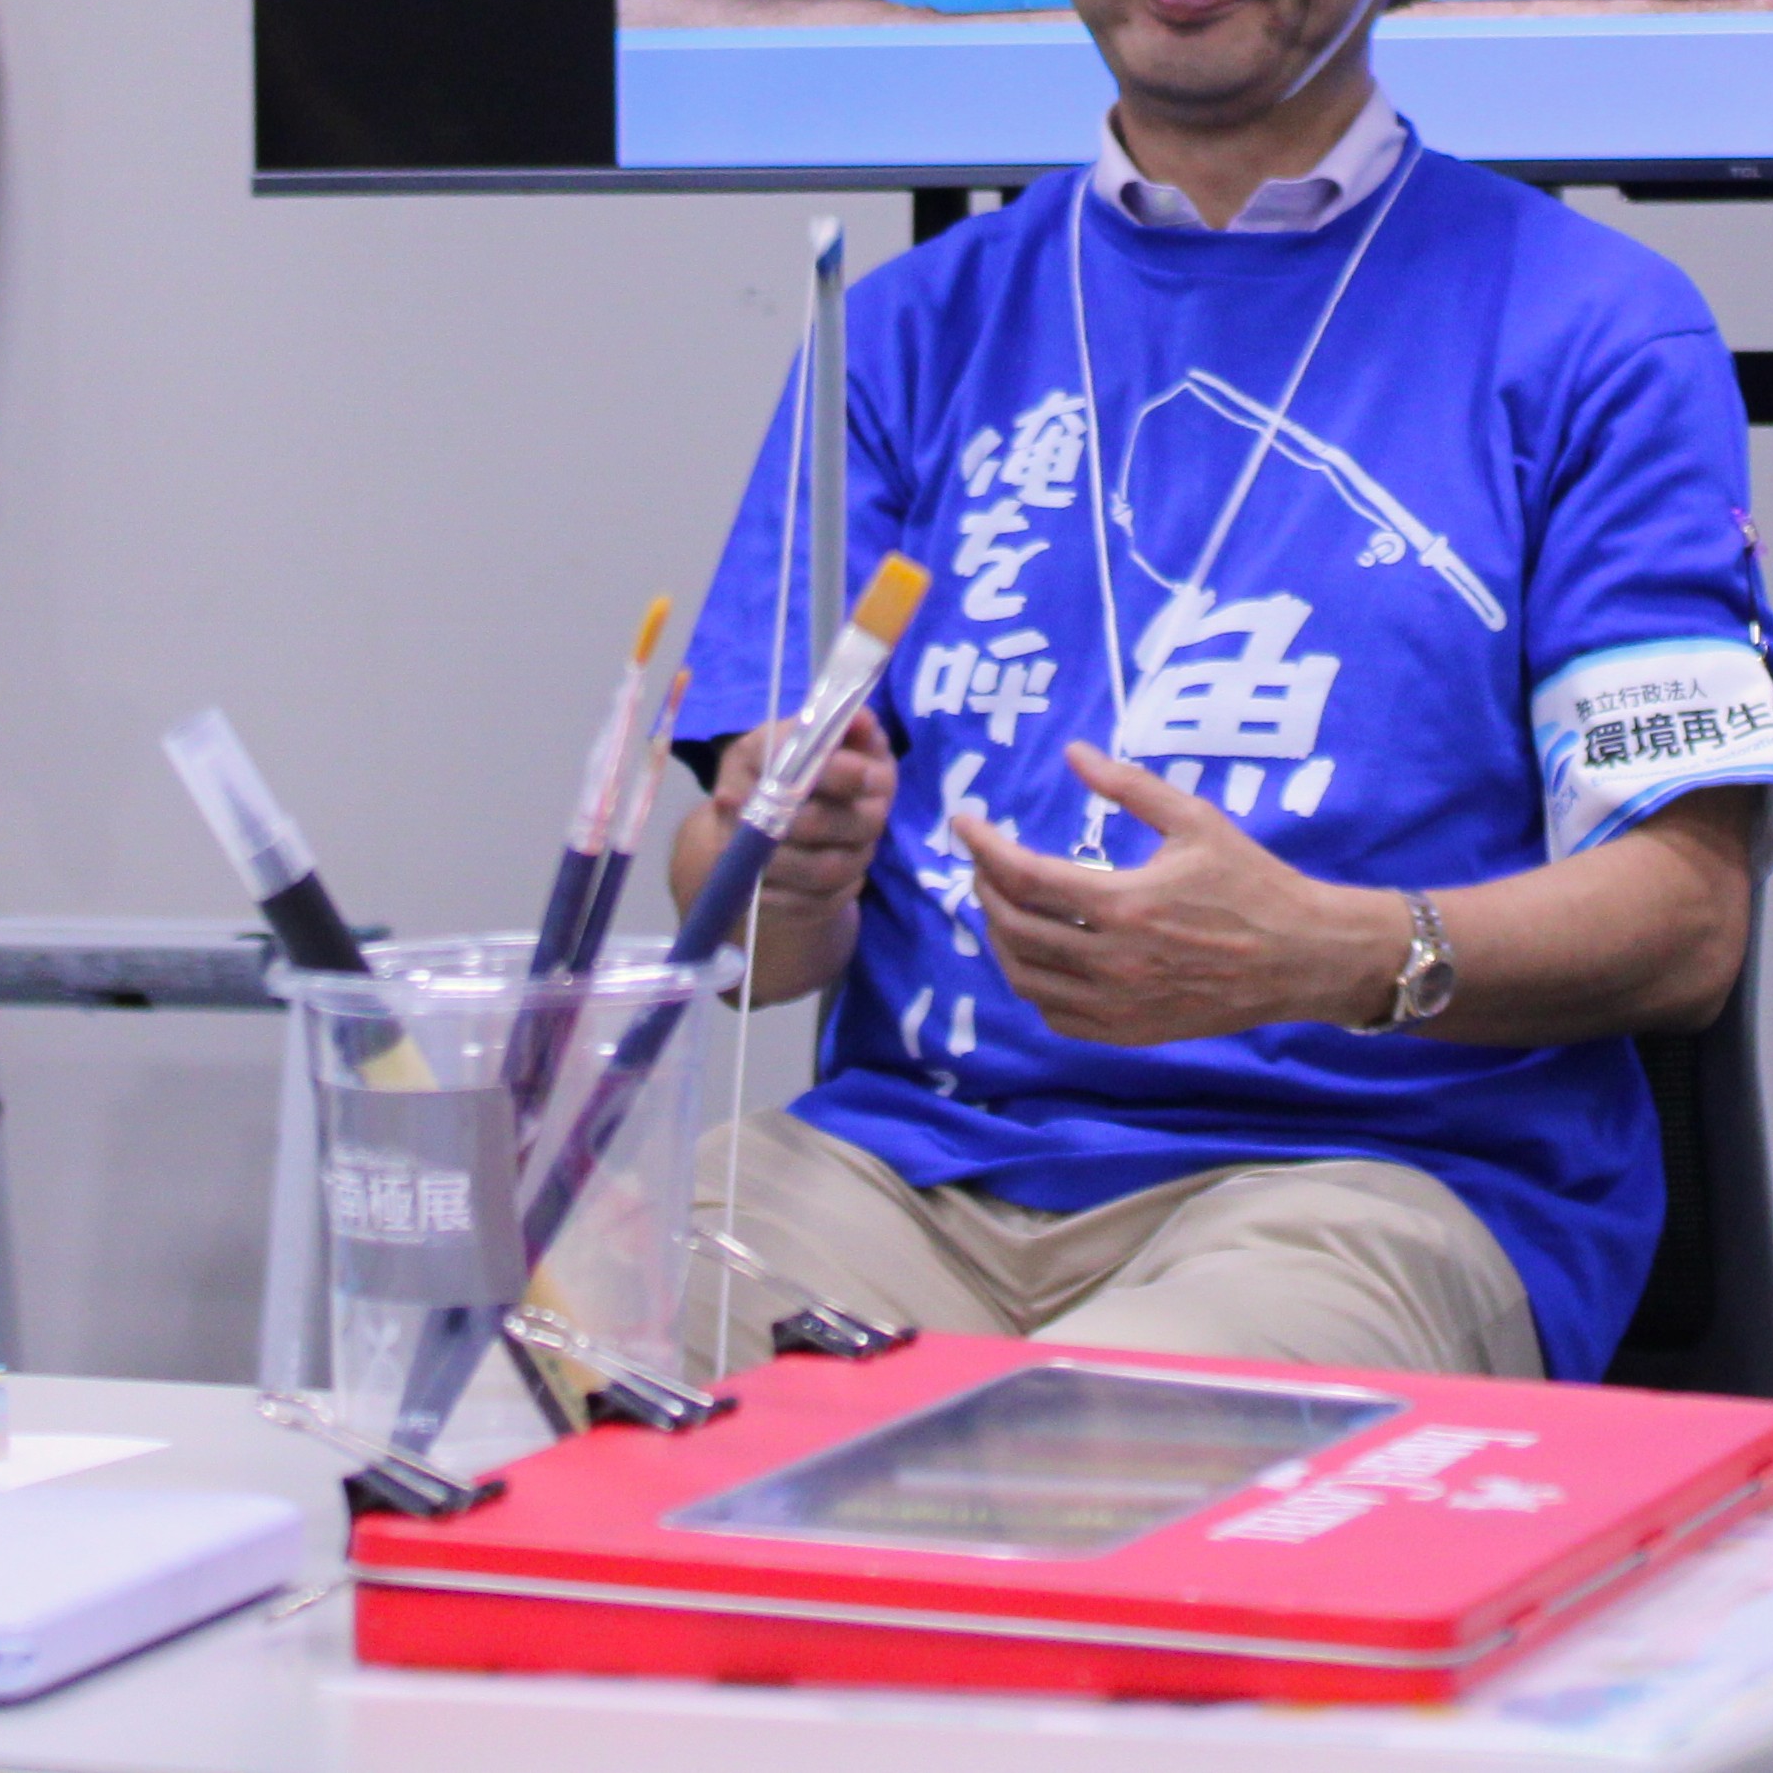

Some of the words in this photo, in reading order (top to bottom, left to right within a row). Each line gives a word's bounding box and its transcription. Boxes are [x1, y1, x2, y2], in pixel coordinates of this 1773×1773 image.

[1576, 678, 1708, 722] 独立行政法人
